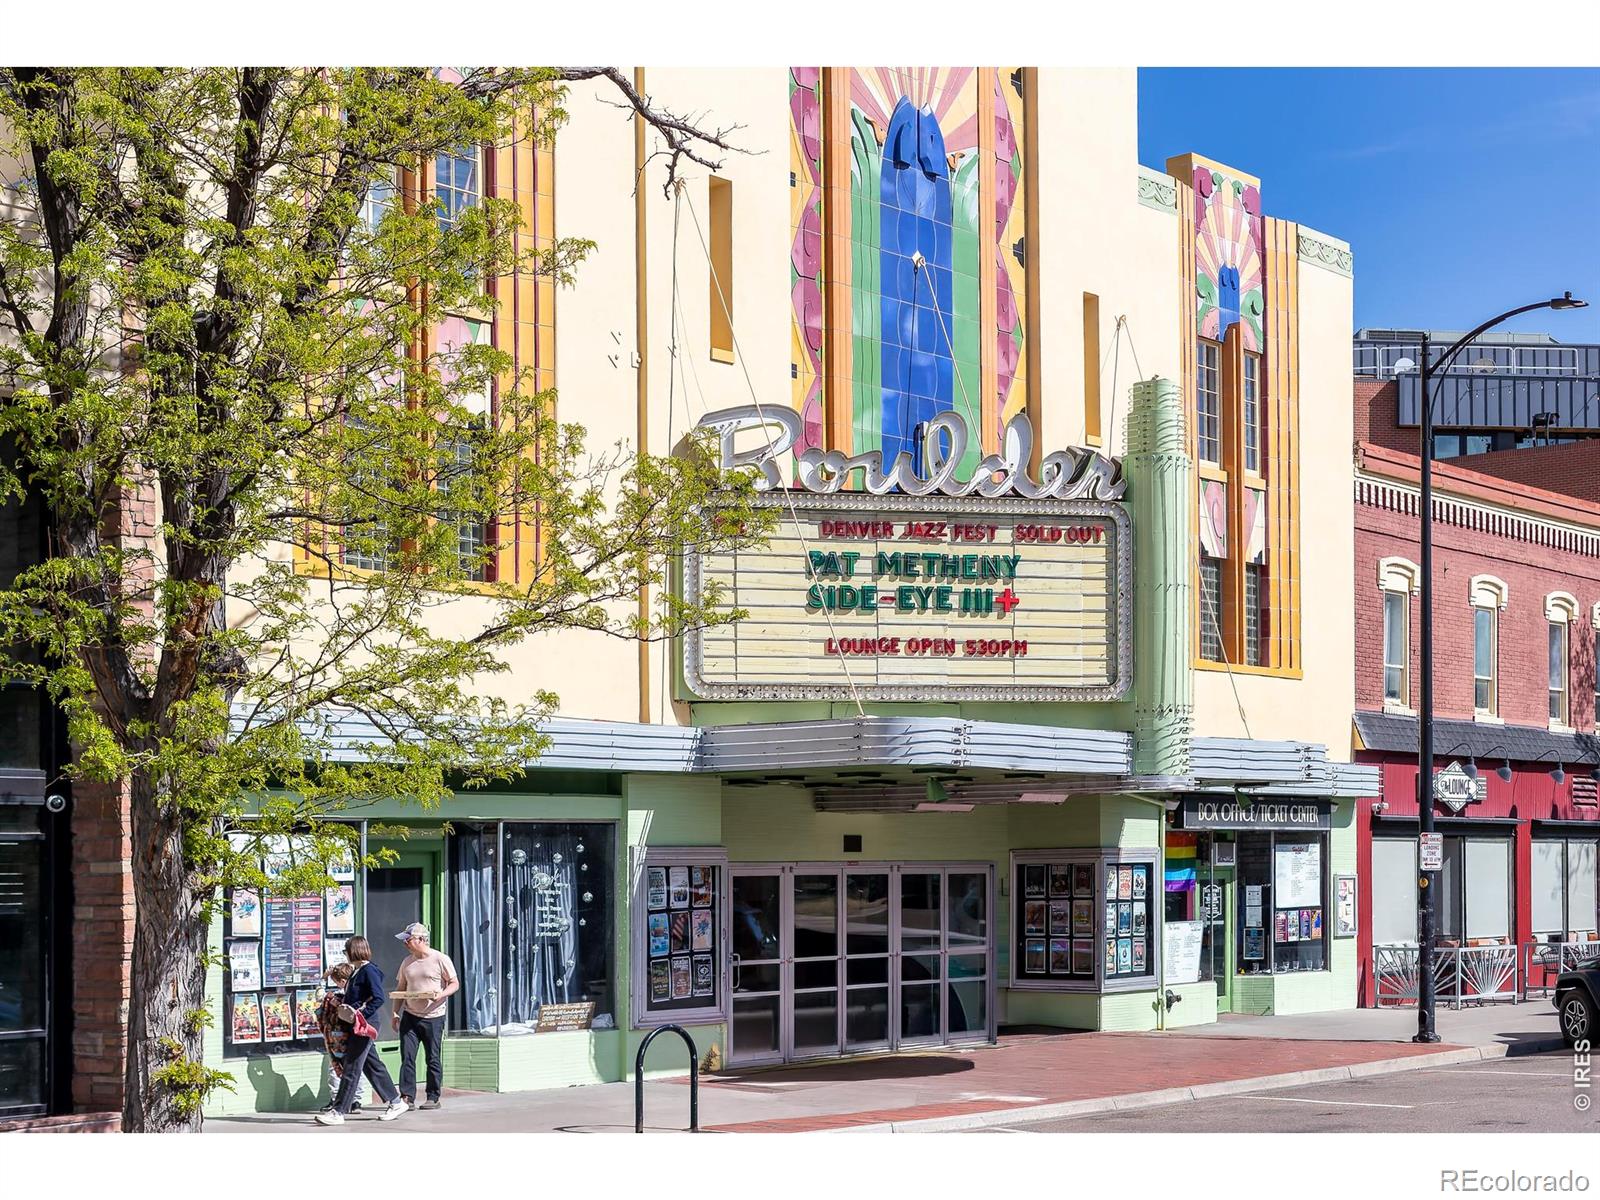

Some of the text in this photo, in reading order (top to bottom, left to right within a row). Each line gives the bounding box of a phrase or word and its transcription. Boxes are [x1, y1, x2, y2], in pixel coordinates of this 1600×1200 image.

[698, 403, 1128, 500] Boulder
[821, 520, 1105, 543] DENVER JAZZ FEST SOLD OUT
[808, 550, 1021, 579] PAT METHENY
[807, 583, 953, 611] SIDE-EYE
[826, 637, 1028, 657] LOUNGE OPEN 530PM
[1449, 778, 1471, 795] LOUNGE
[1198, 803, 1219, 821] BOX
[1290, 805, 1319, 823] CENTER
